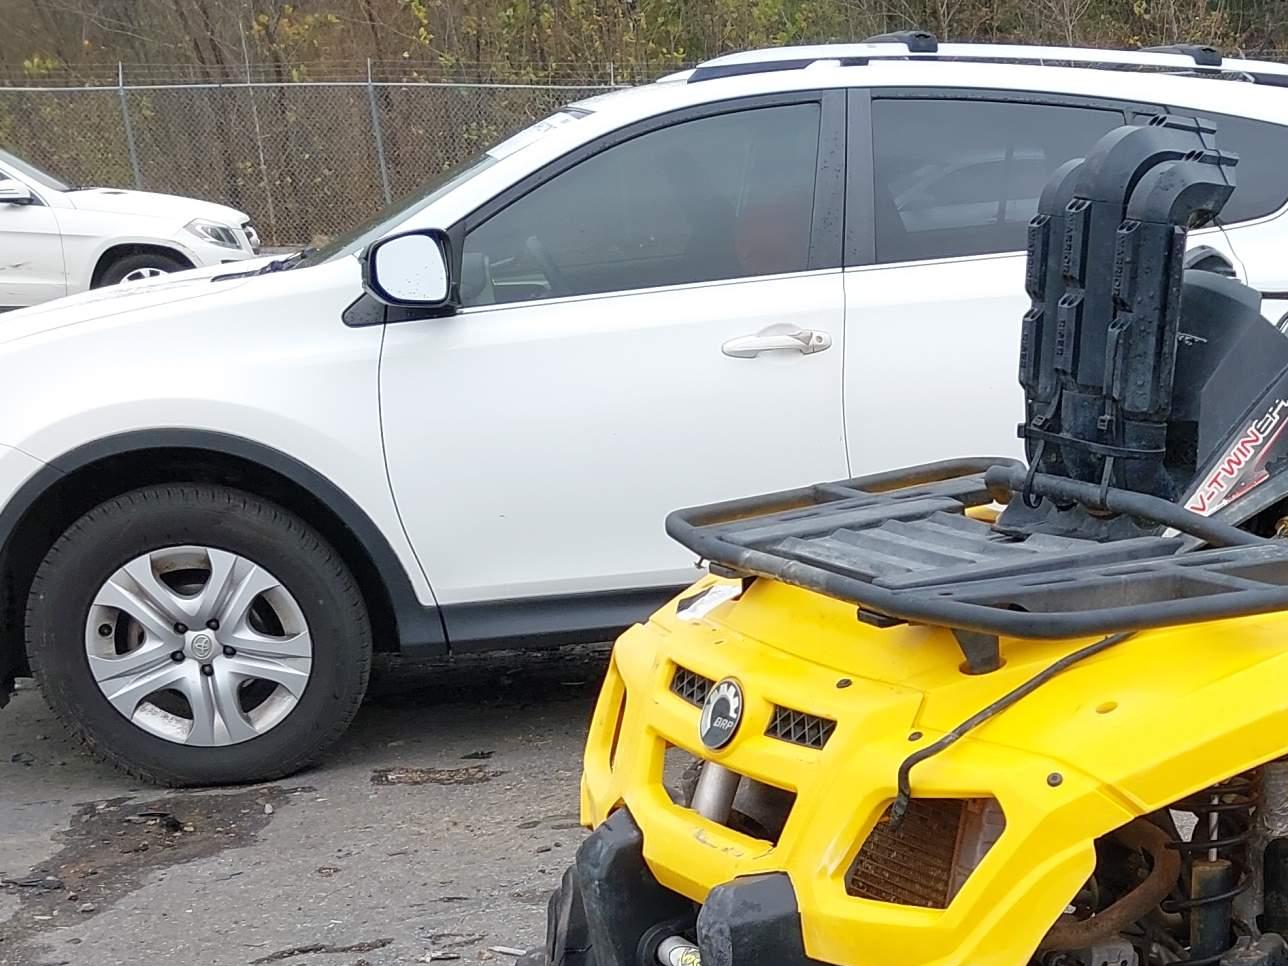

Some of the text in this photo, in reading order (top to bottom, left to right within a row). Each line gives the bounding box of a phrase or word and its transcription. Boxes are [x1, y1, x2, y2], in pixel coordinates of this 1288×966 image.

[1063, 211, 1075, 275] WARRIOR
[1188, 428, 1262, 513] V-TWIN
[713, 716, 734, 730] BRP
